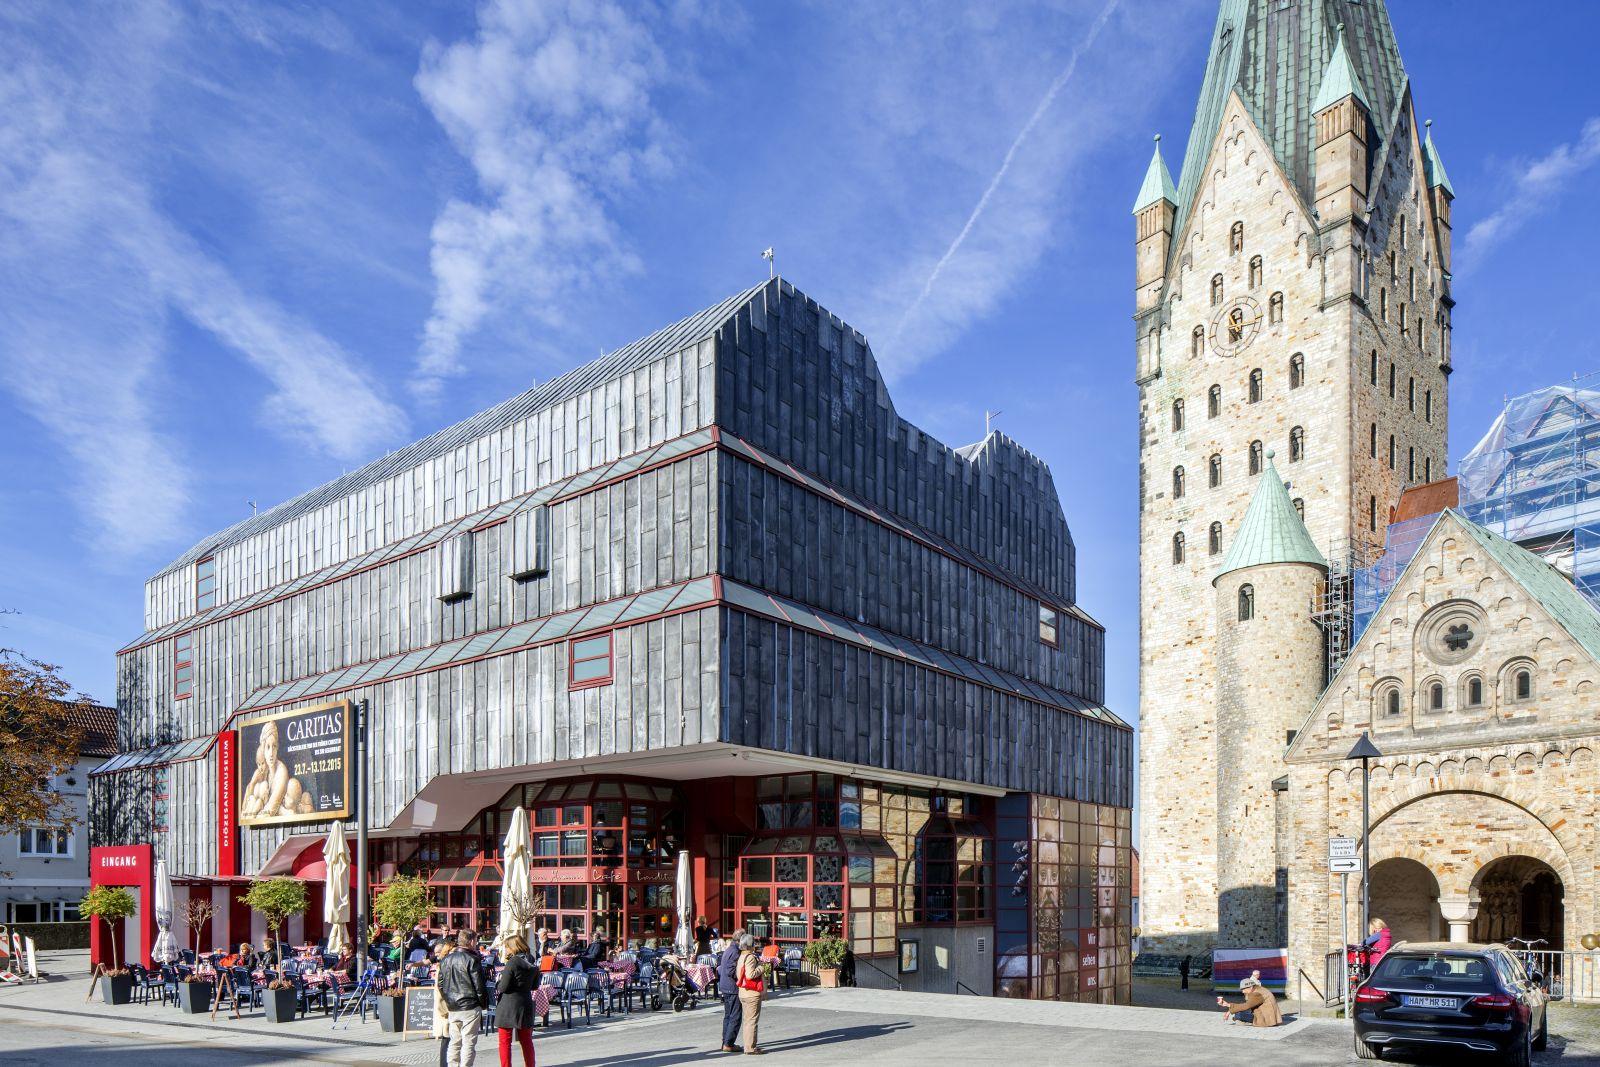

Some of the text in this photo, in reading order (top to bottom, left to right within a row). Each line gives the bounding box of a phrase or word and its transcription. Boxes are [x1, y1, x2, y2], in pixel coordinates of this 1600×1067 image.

[287, 712, 342, 741] CARITAS
[102, 855, 137, 867] EINGANG
[1409, 996, 1424, 1005] HAM
[1441, 998, 1456, 1007] 511
